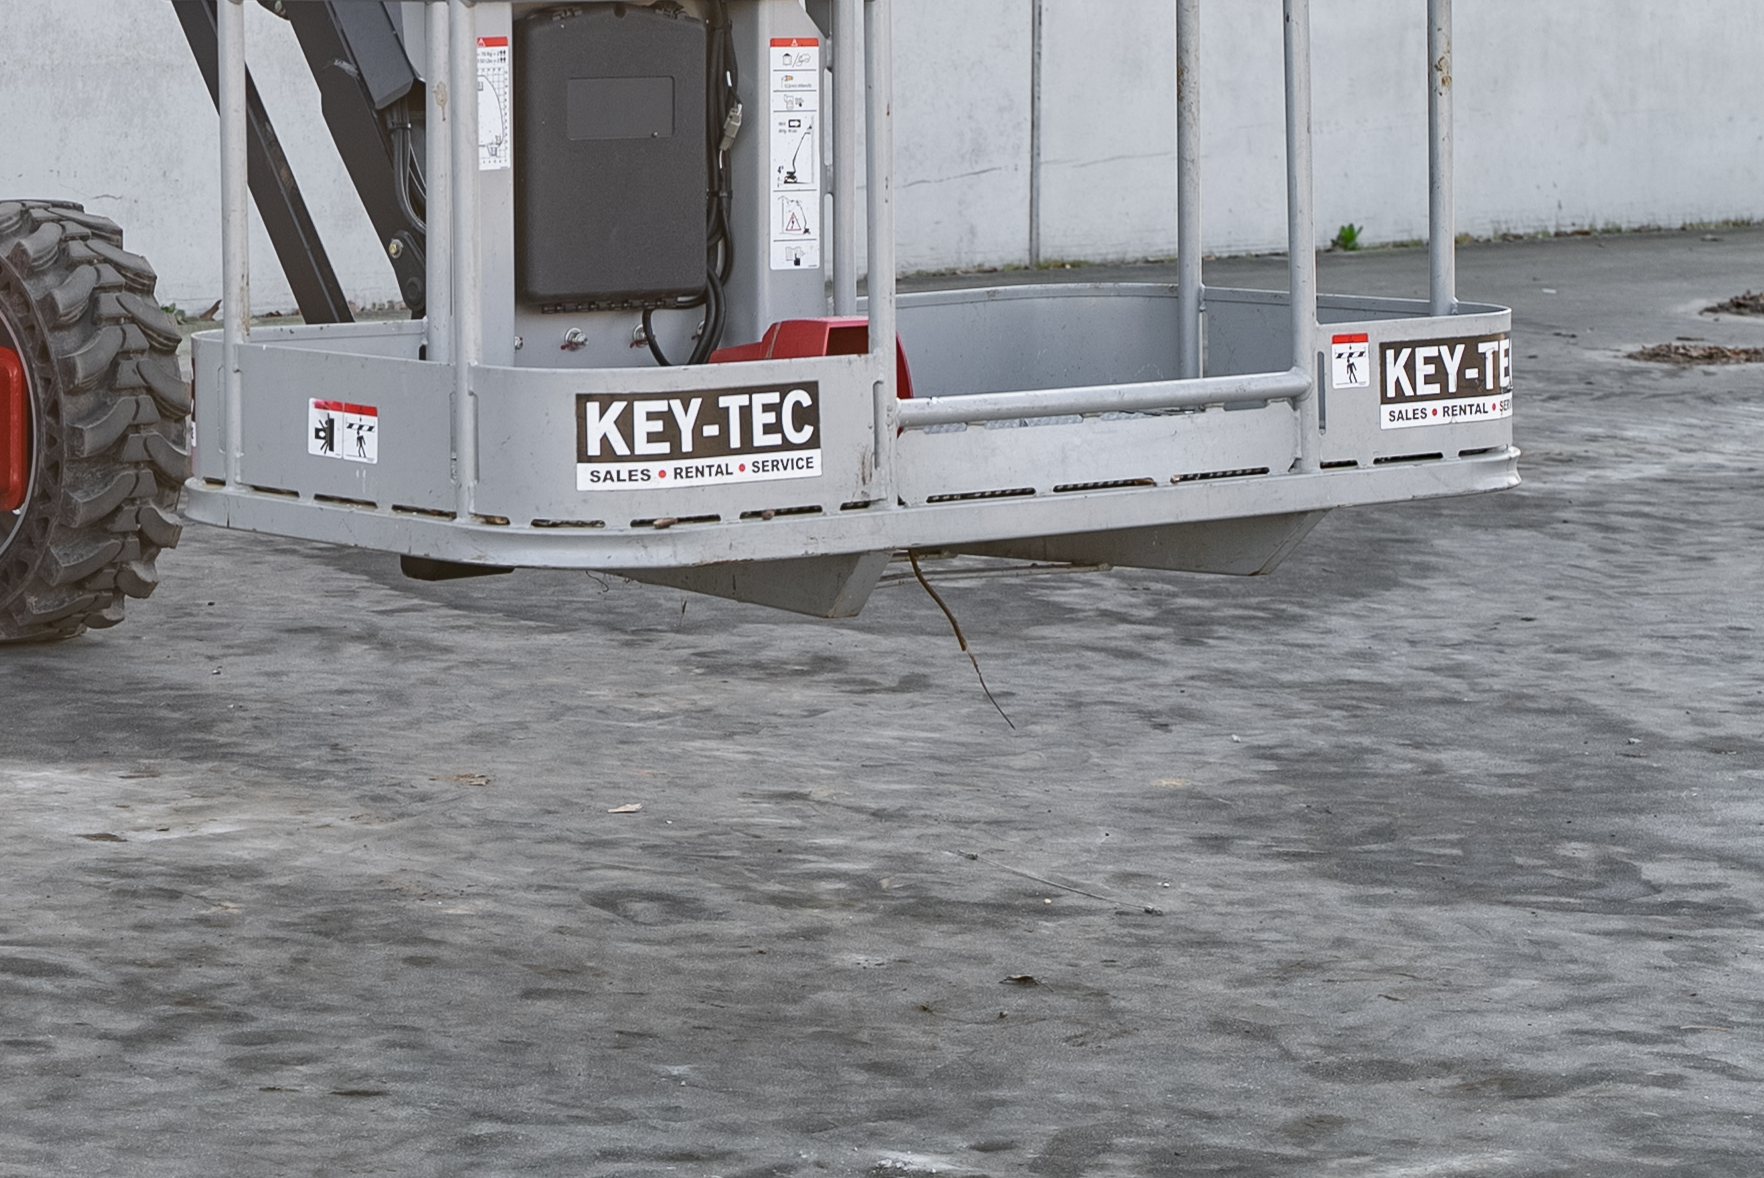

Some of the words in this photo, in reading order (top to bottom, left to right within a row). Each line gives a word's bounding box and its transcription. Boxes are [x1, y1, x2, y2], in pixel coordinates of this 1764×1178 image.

[1386, 338, 1512, 398] KEY-TE
[586, 389, 814, 457] KEY-TEC
[1389, 407, 1428, 422] SALES
[1442, 402, 1489, 417] RENTAL
[590, 468, 652, 483] SALES
[673, 463, 734, 480] RENTAL
[751, 456, 814, 473] SERVICE
